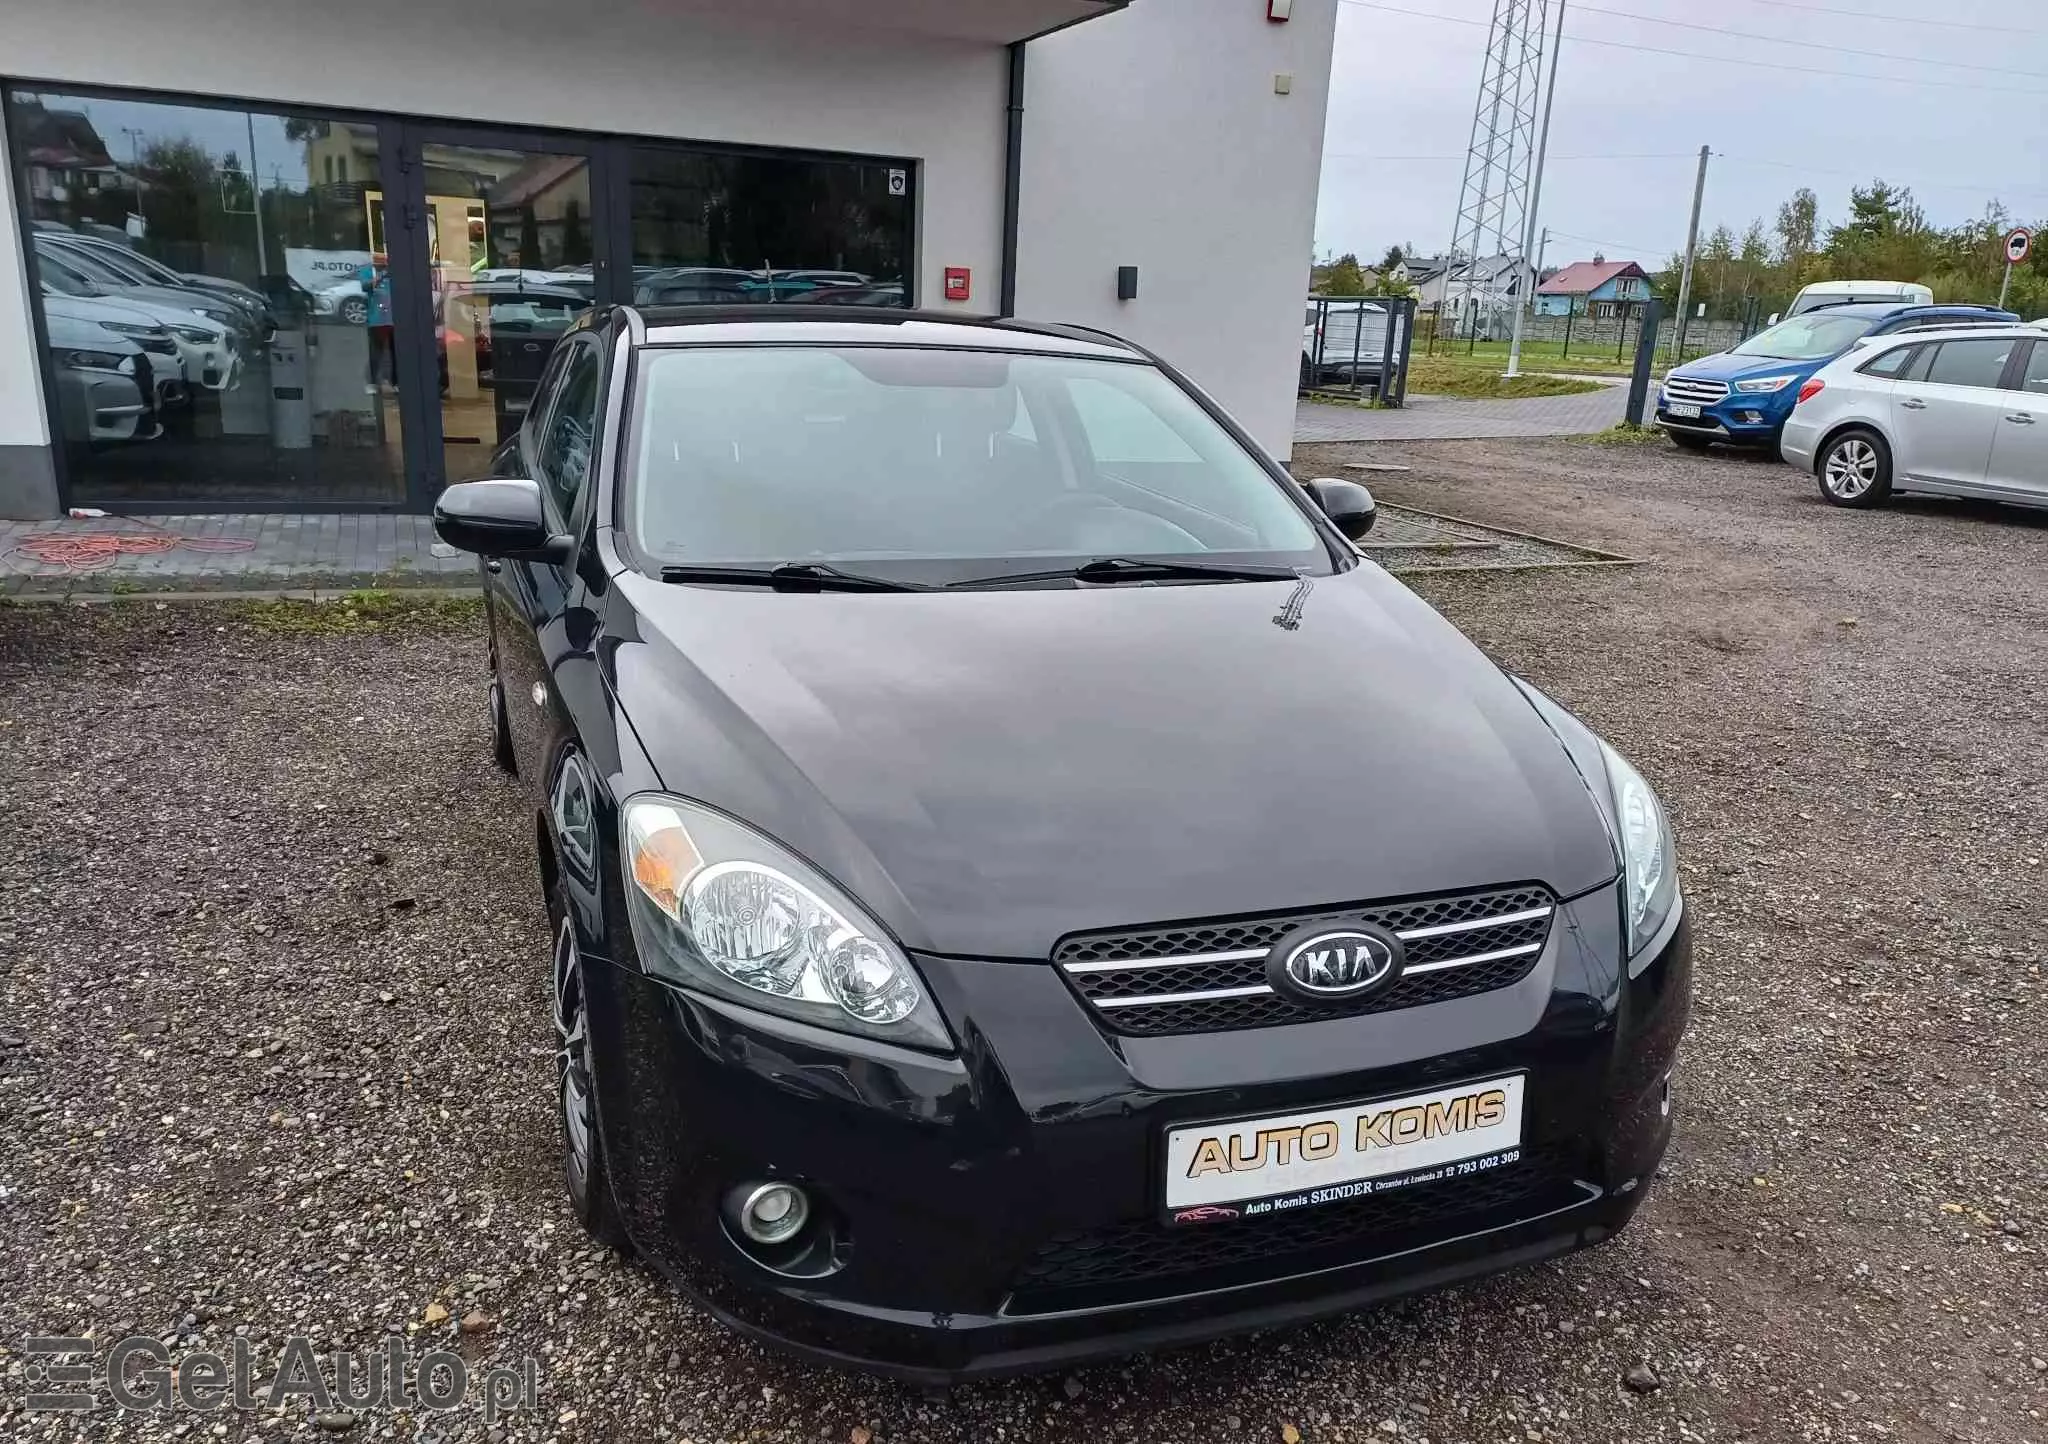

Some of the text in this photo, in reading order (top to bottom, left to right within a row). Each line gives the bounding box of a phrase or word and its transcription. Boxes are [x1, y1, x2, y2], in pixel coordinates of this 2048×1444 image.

[1305, 946, 1376, 984] KIA
[1186, 1121, 1339, 1179] AUTO
[1355, 1089, 1506, 1152] KOMIS
[1245, 1201, 1271, 1215] Auto
[1274, 1195, 1308, 1210] Komis
[1311, 1181, 1372, 1204] SKINDER
[1457, 1161, 1477, 1175] 793
[1479, 1156, 1499, 1170] 002
[1501, 1150, 1520, 1164] 309
